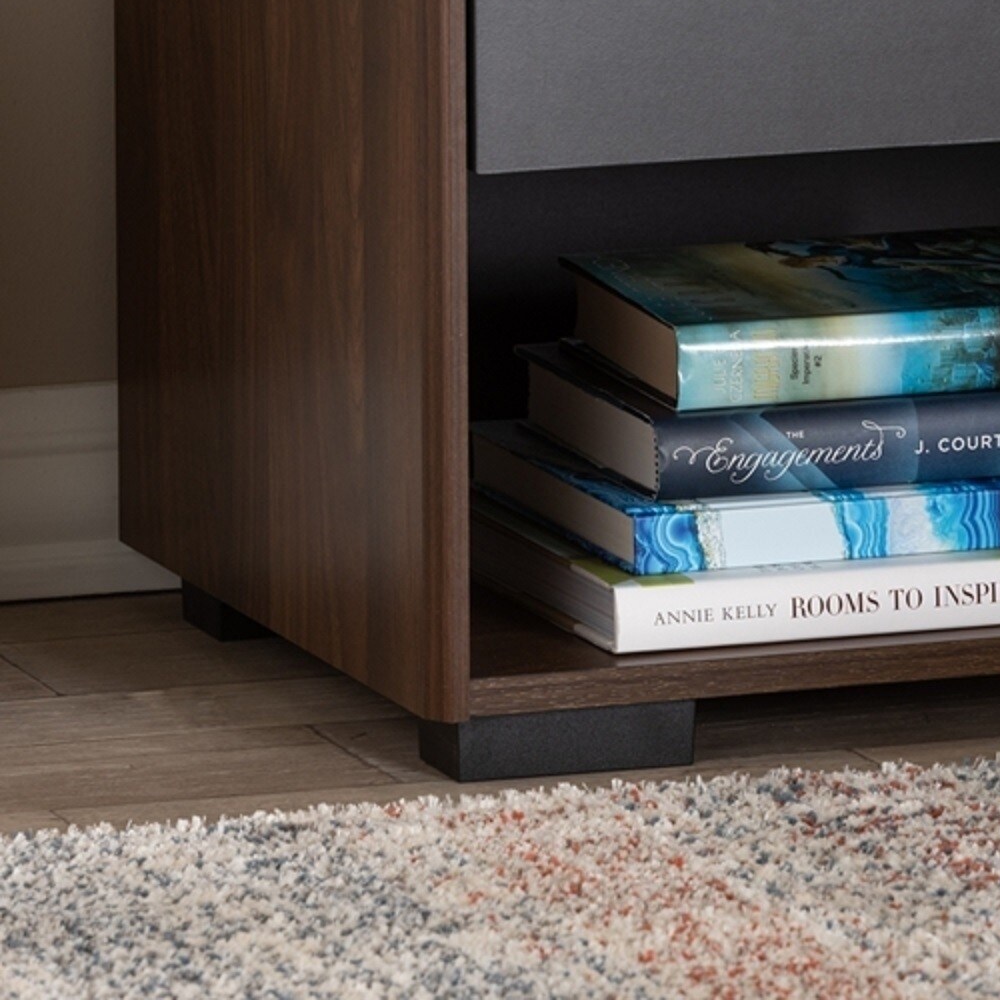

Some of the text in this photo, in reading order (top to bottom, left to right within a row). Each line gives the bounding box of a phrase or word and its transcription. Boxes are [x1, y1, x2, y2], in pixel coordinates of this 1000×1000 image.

[786, 430, 804, 440] THE
[672, 419, 906, 484] Engagements
[914, 440, 930, 455] J.
[653, 603, 778, 626] ANNIE KELLY
[791, 589, 880, 619] ROOMS
[889, 588, 923, 611] TO
